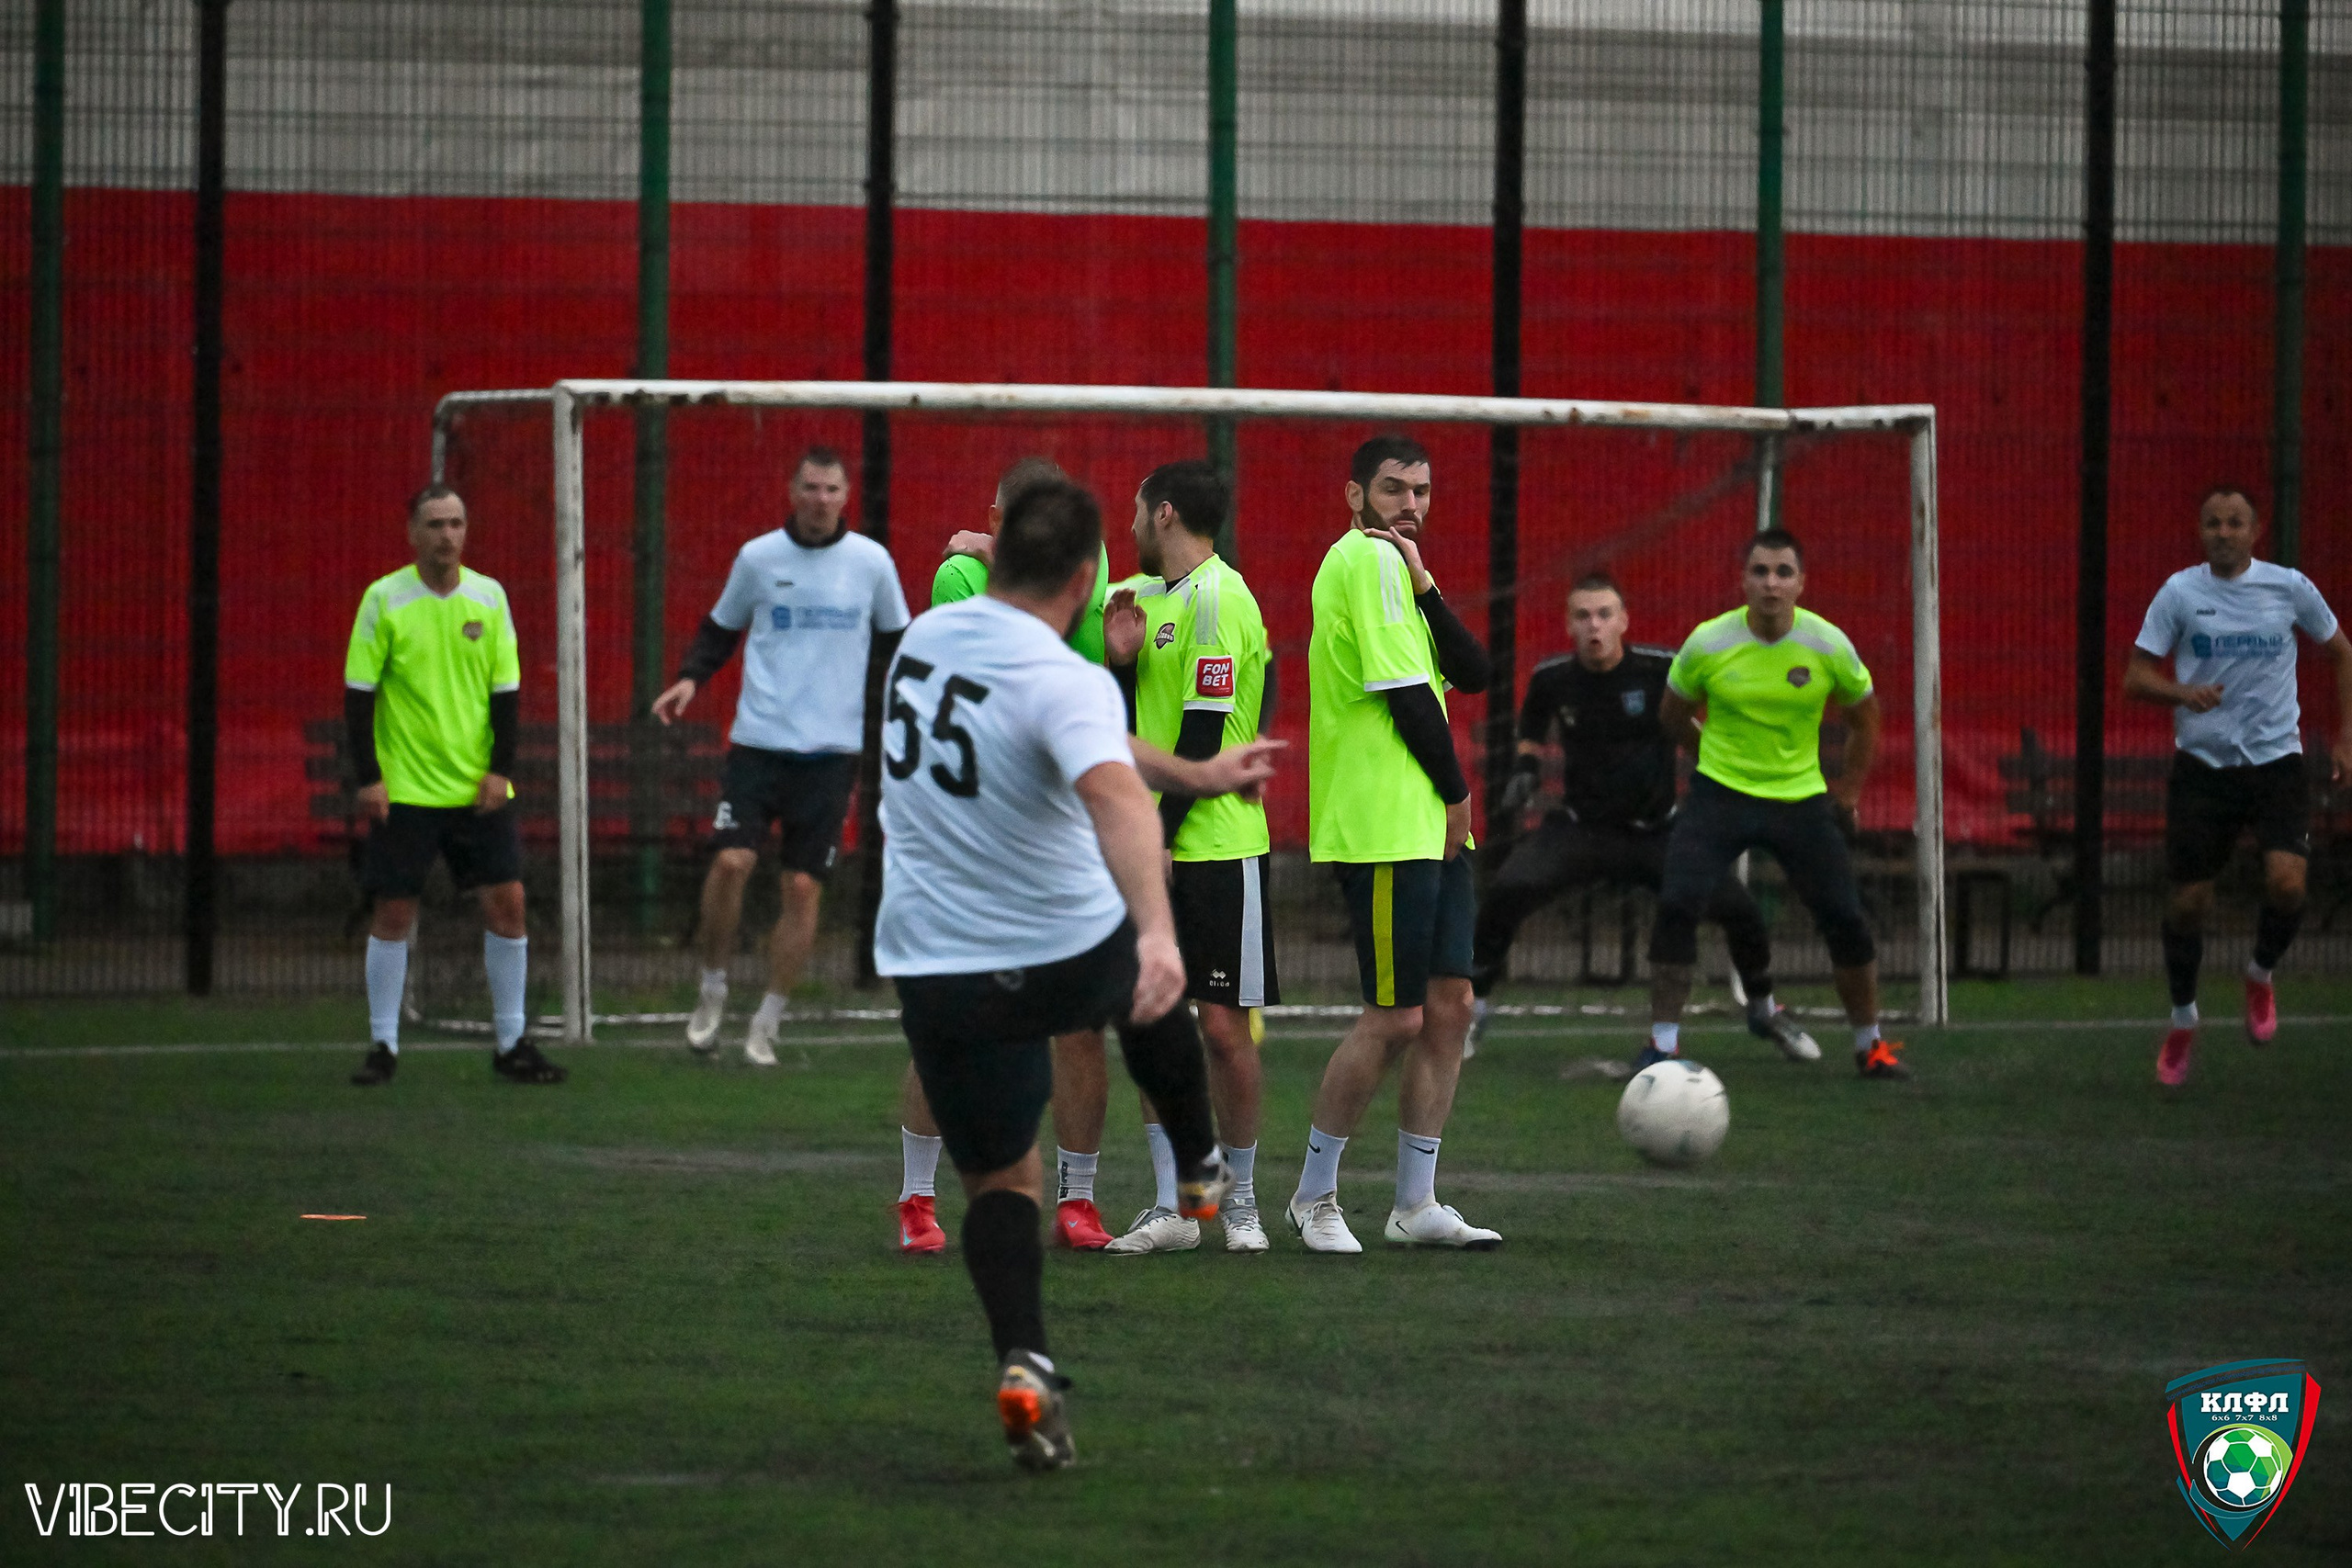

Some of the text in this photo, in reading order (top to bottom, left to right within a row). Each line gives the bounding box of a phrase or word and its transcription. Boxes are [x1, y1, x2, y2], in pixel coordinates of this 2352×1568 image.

[1203, 662, 1230, 675] FON
[1202, 673, 1229, 687] BET
[887, 654, 990, 797] 55
